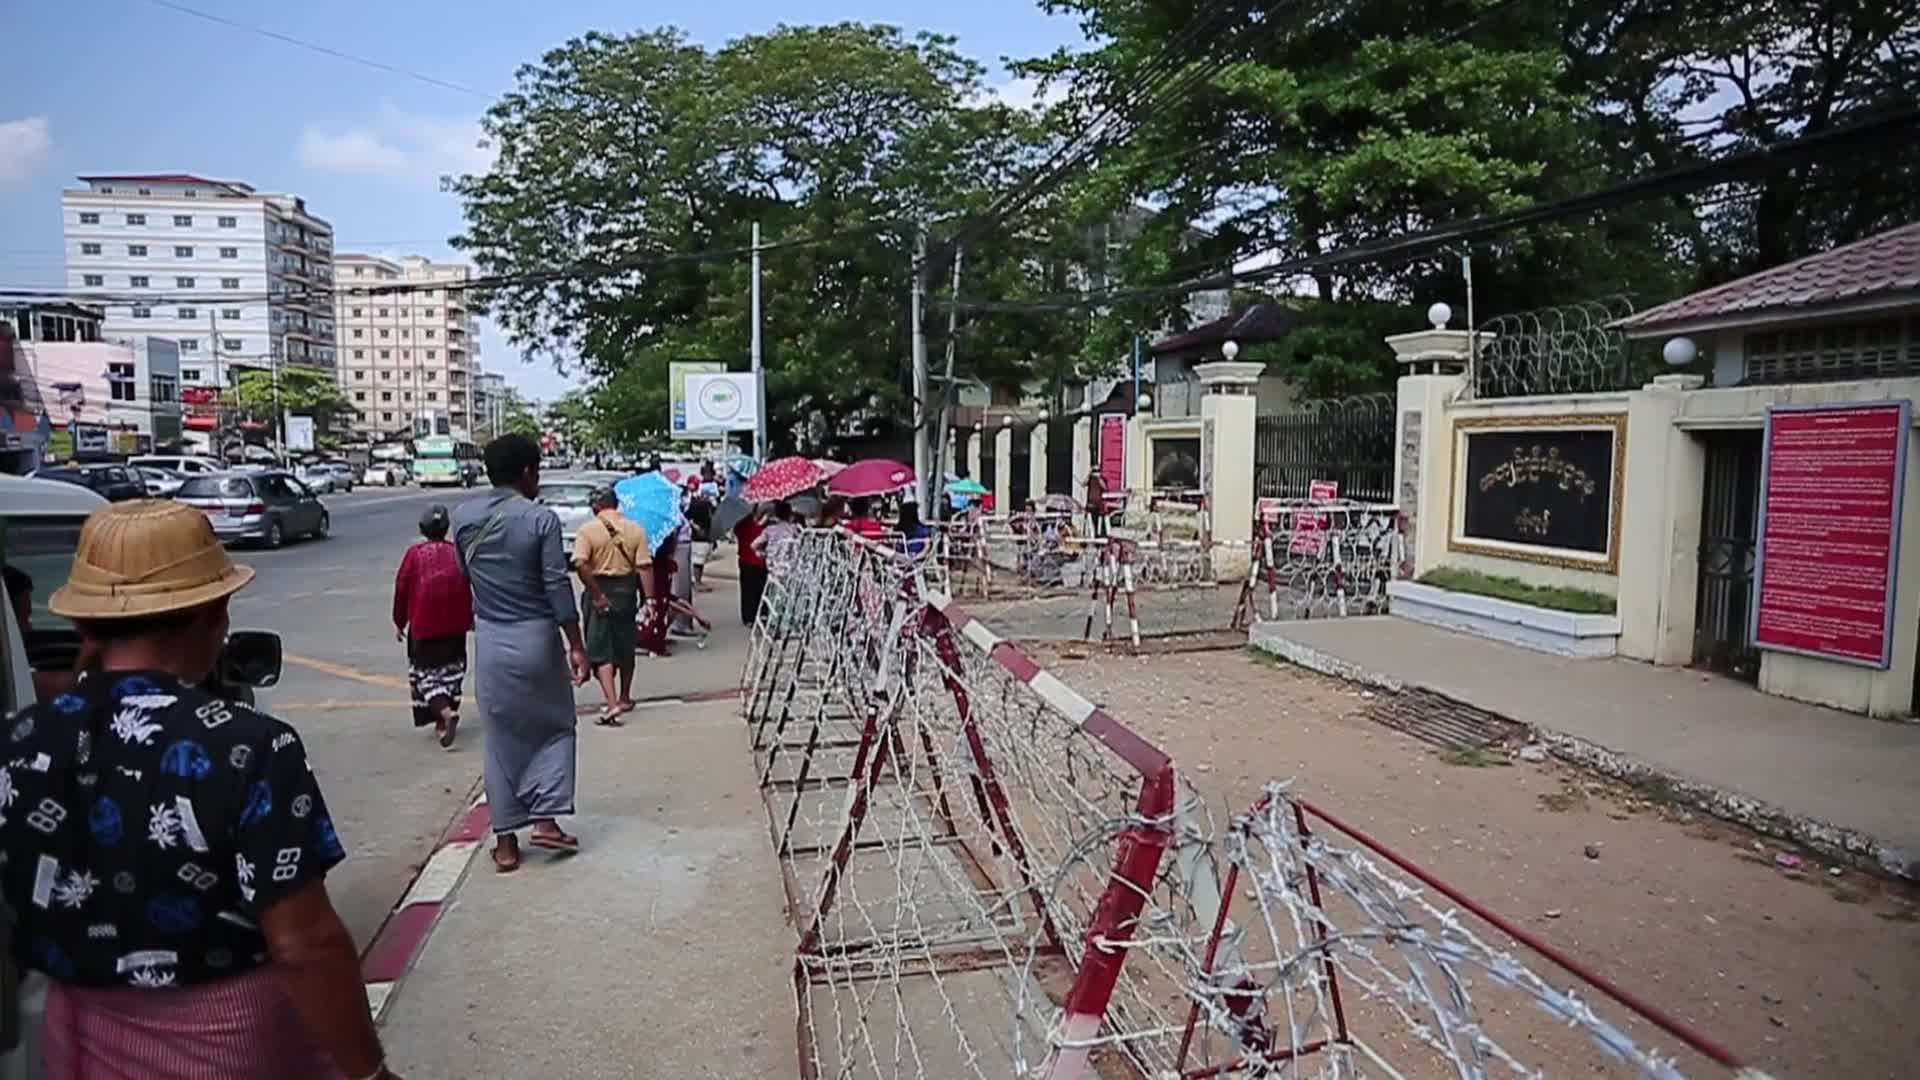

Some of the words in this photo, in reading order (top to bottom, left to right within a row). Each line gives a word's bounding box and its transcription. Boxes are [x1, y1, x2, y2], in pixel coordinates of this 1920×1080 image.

[195, 699, 233, 729] 89
[27, 798, 67, 832] 89
[272, 847, 302, 881] 89
